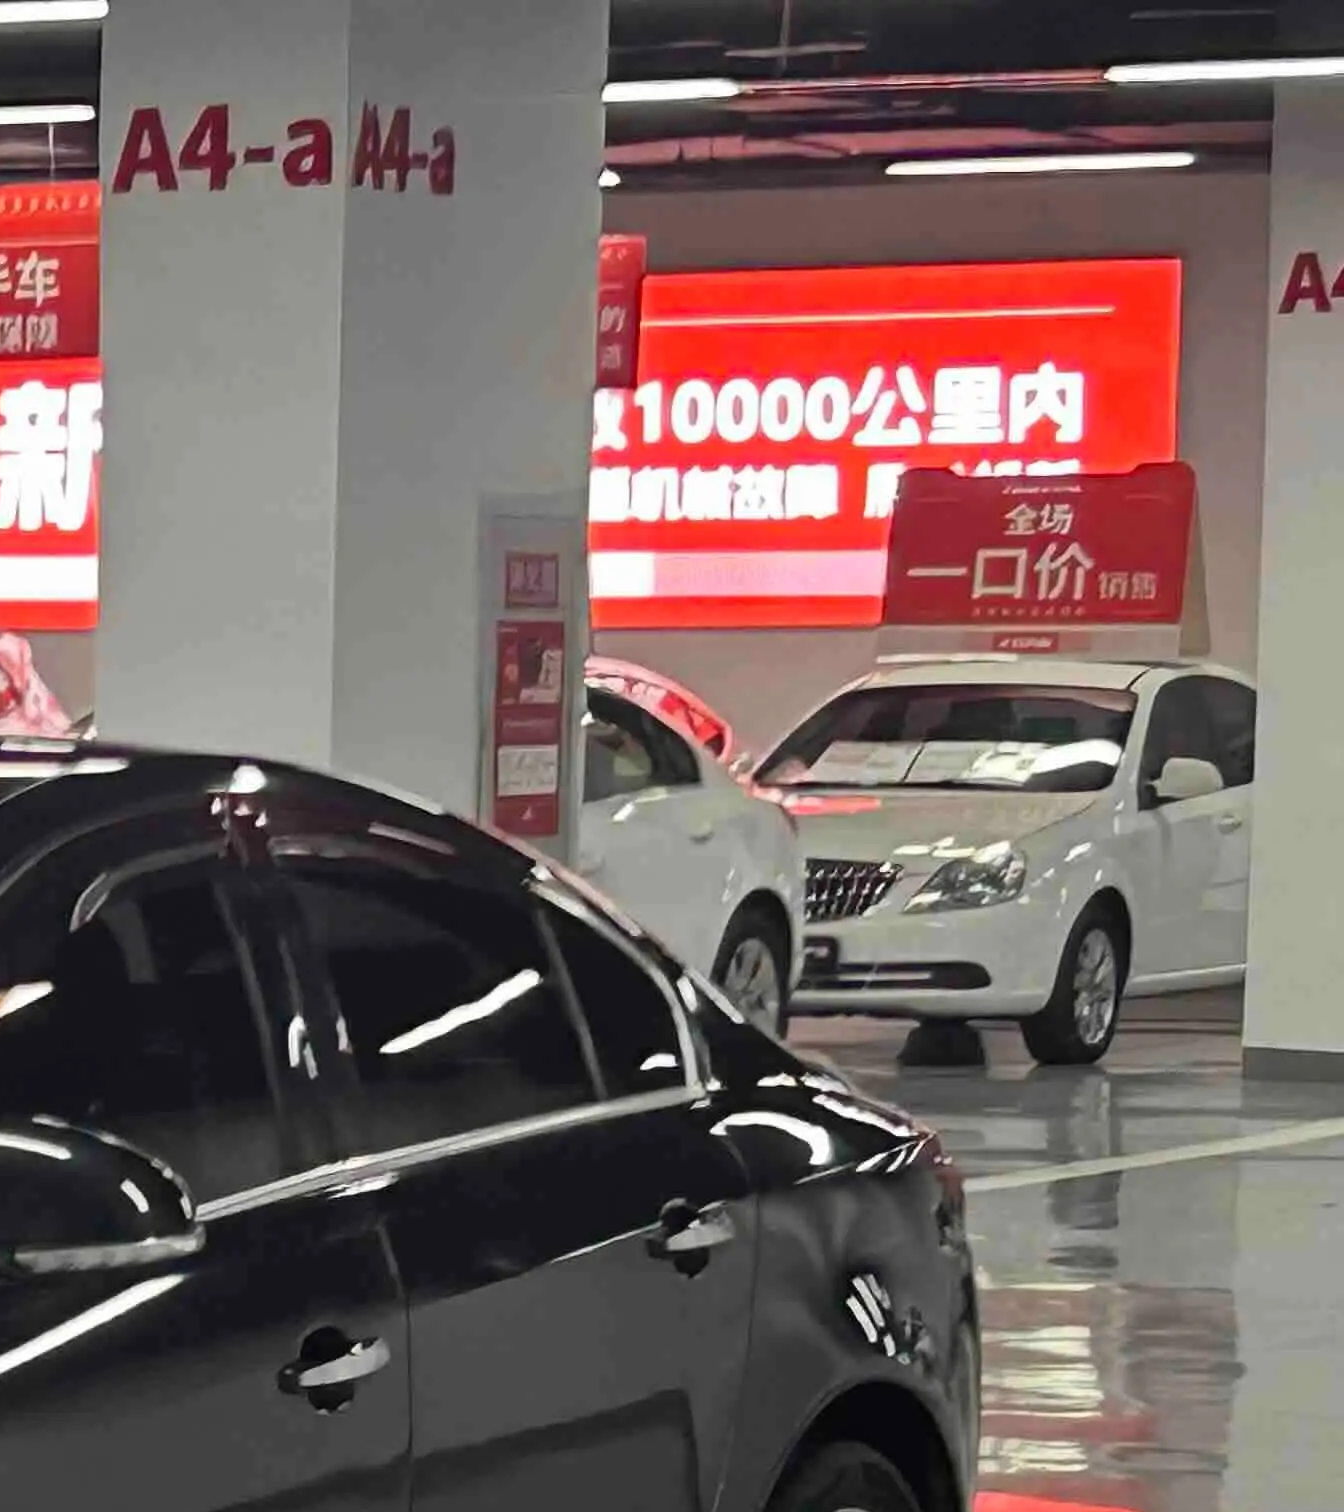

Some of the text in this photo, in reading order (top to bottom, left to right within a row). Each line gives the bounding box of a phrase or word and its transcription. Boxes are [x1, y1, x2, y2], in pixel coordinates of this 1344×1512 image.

[112, 104, 333, 193] A4-a
[351, 98, 456, 195] A4-a
[906, 541, 1096, 601] 一口价
